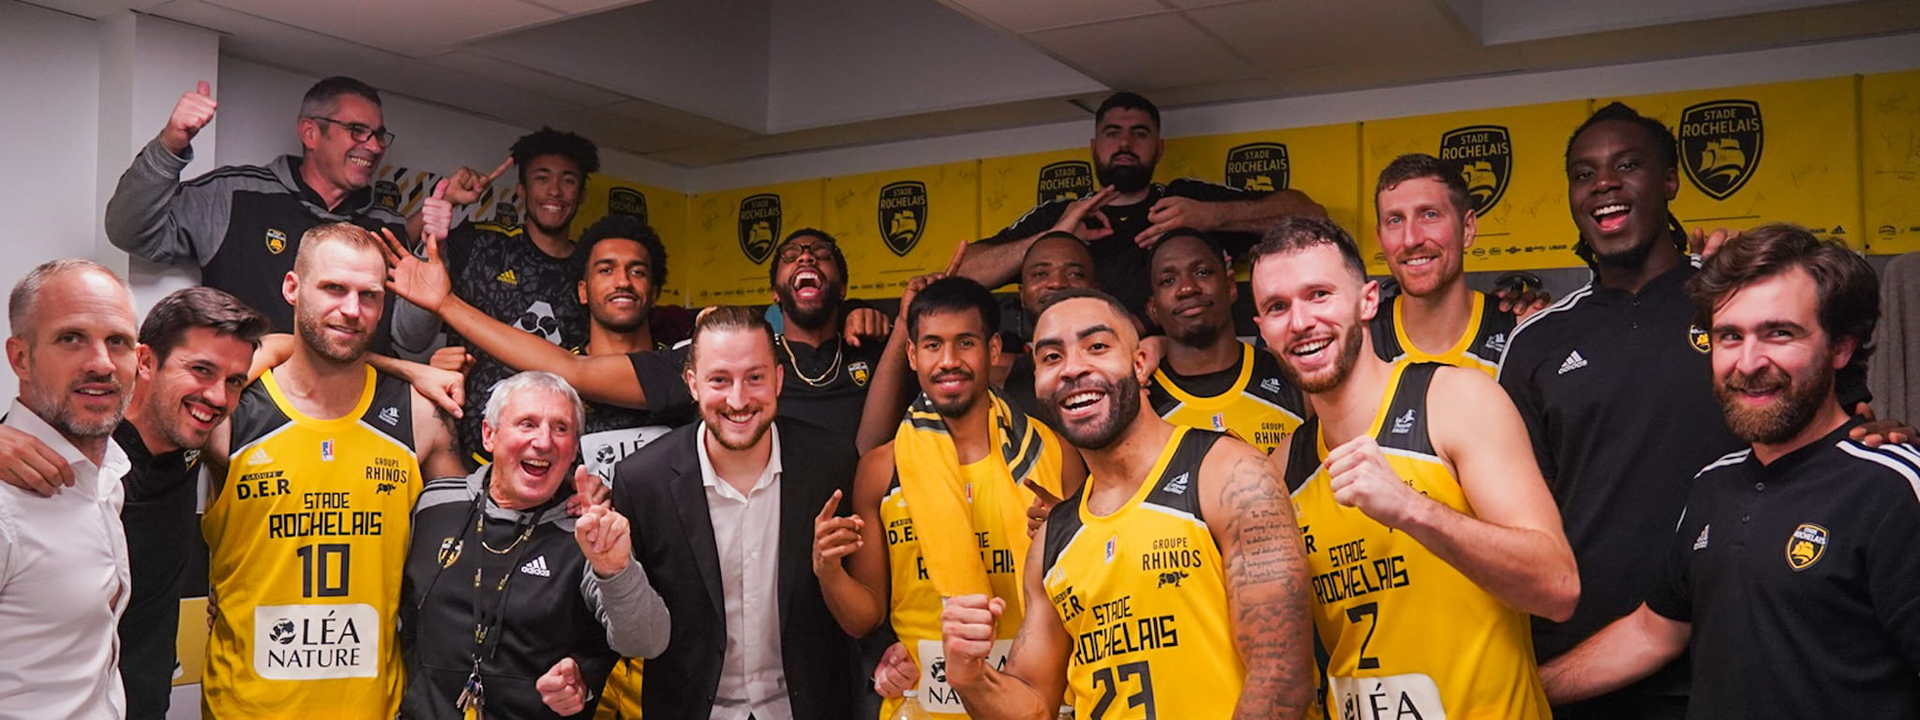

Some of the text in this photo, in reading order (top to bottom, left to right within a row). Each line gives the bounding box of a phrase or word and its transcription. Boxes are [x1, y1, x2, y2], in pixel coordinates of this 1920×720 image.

[1704, 108, 1737, 121] STADE
[1682, 118, 1760, 137] ROCHELAIS
[1460, 133, 1489, 145] STADE
[1245, 149, 1270, 161] STADE
[1442, 142, 1509, 160] ROCHELAIS
[1054, 167, 1076, 178] STADE
[1228, 158, 1287, 174] ROCHELAIS
[1041, 175, 1091, 190] ROCHELAIS
[892, 187, 912, 197] STADE
[880, 195, 926, 209] ROCHELAIS
[740, 207, 780, 220] ROCHELAIS
[1261, 422, 1285, 431] GROUPE
[1254, 431, 1291, 444] RHINO
[375, 457, 399, 468] GROUPE
[366, 466, 407, 484] RHINOS
[237, 479, 291, 500] D.E.R
[304, 492, 350, 509] STADE
[269, 512, 382, 538] ROCHELAIS
[1153, 537, 1188, 550] GROUPE
[1142, 550, 1202, 571] RHINOS
[1329, 538, 1367, 568] STADE
[297, 543, 350, 598] 10
[521, 566, 550, 577] adidas
[1311, 555, 1410, 606] ROCHELAIS
[1092, 596, 1134, 626] STADE
[303, 610, 360, 645] LÉA
[1346, 602, 1380, 670] 2
[1073, 614, 1179, 667] ROCHELAIS
[268, 648, 360, 668] NATURE
[1089, 660, 1157, 720] 23
